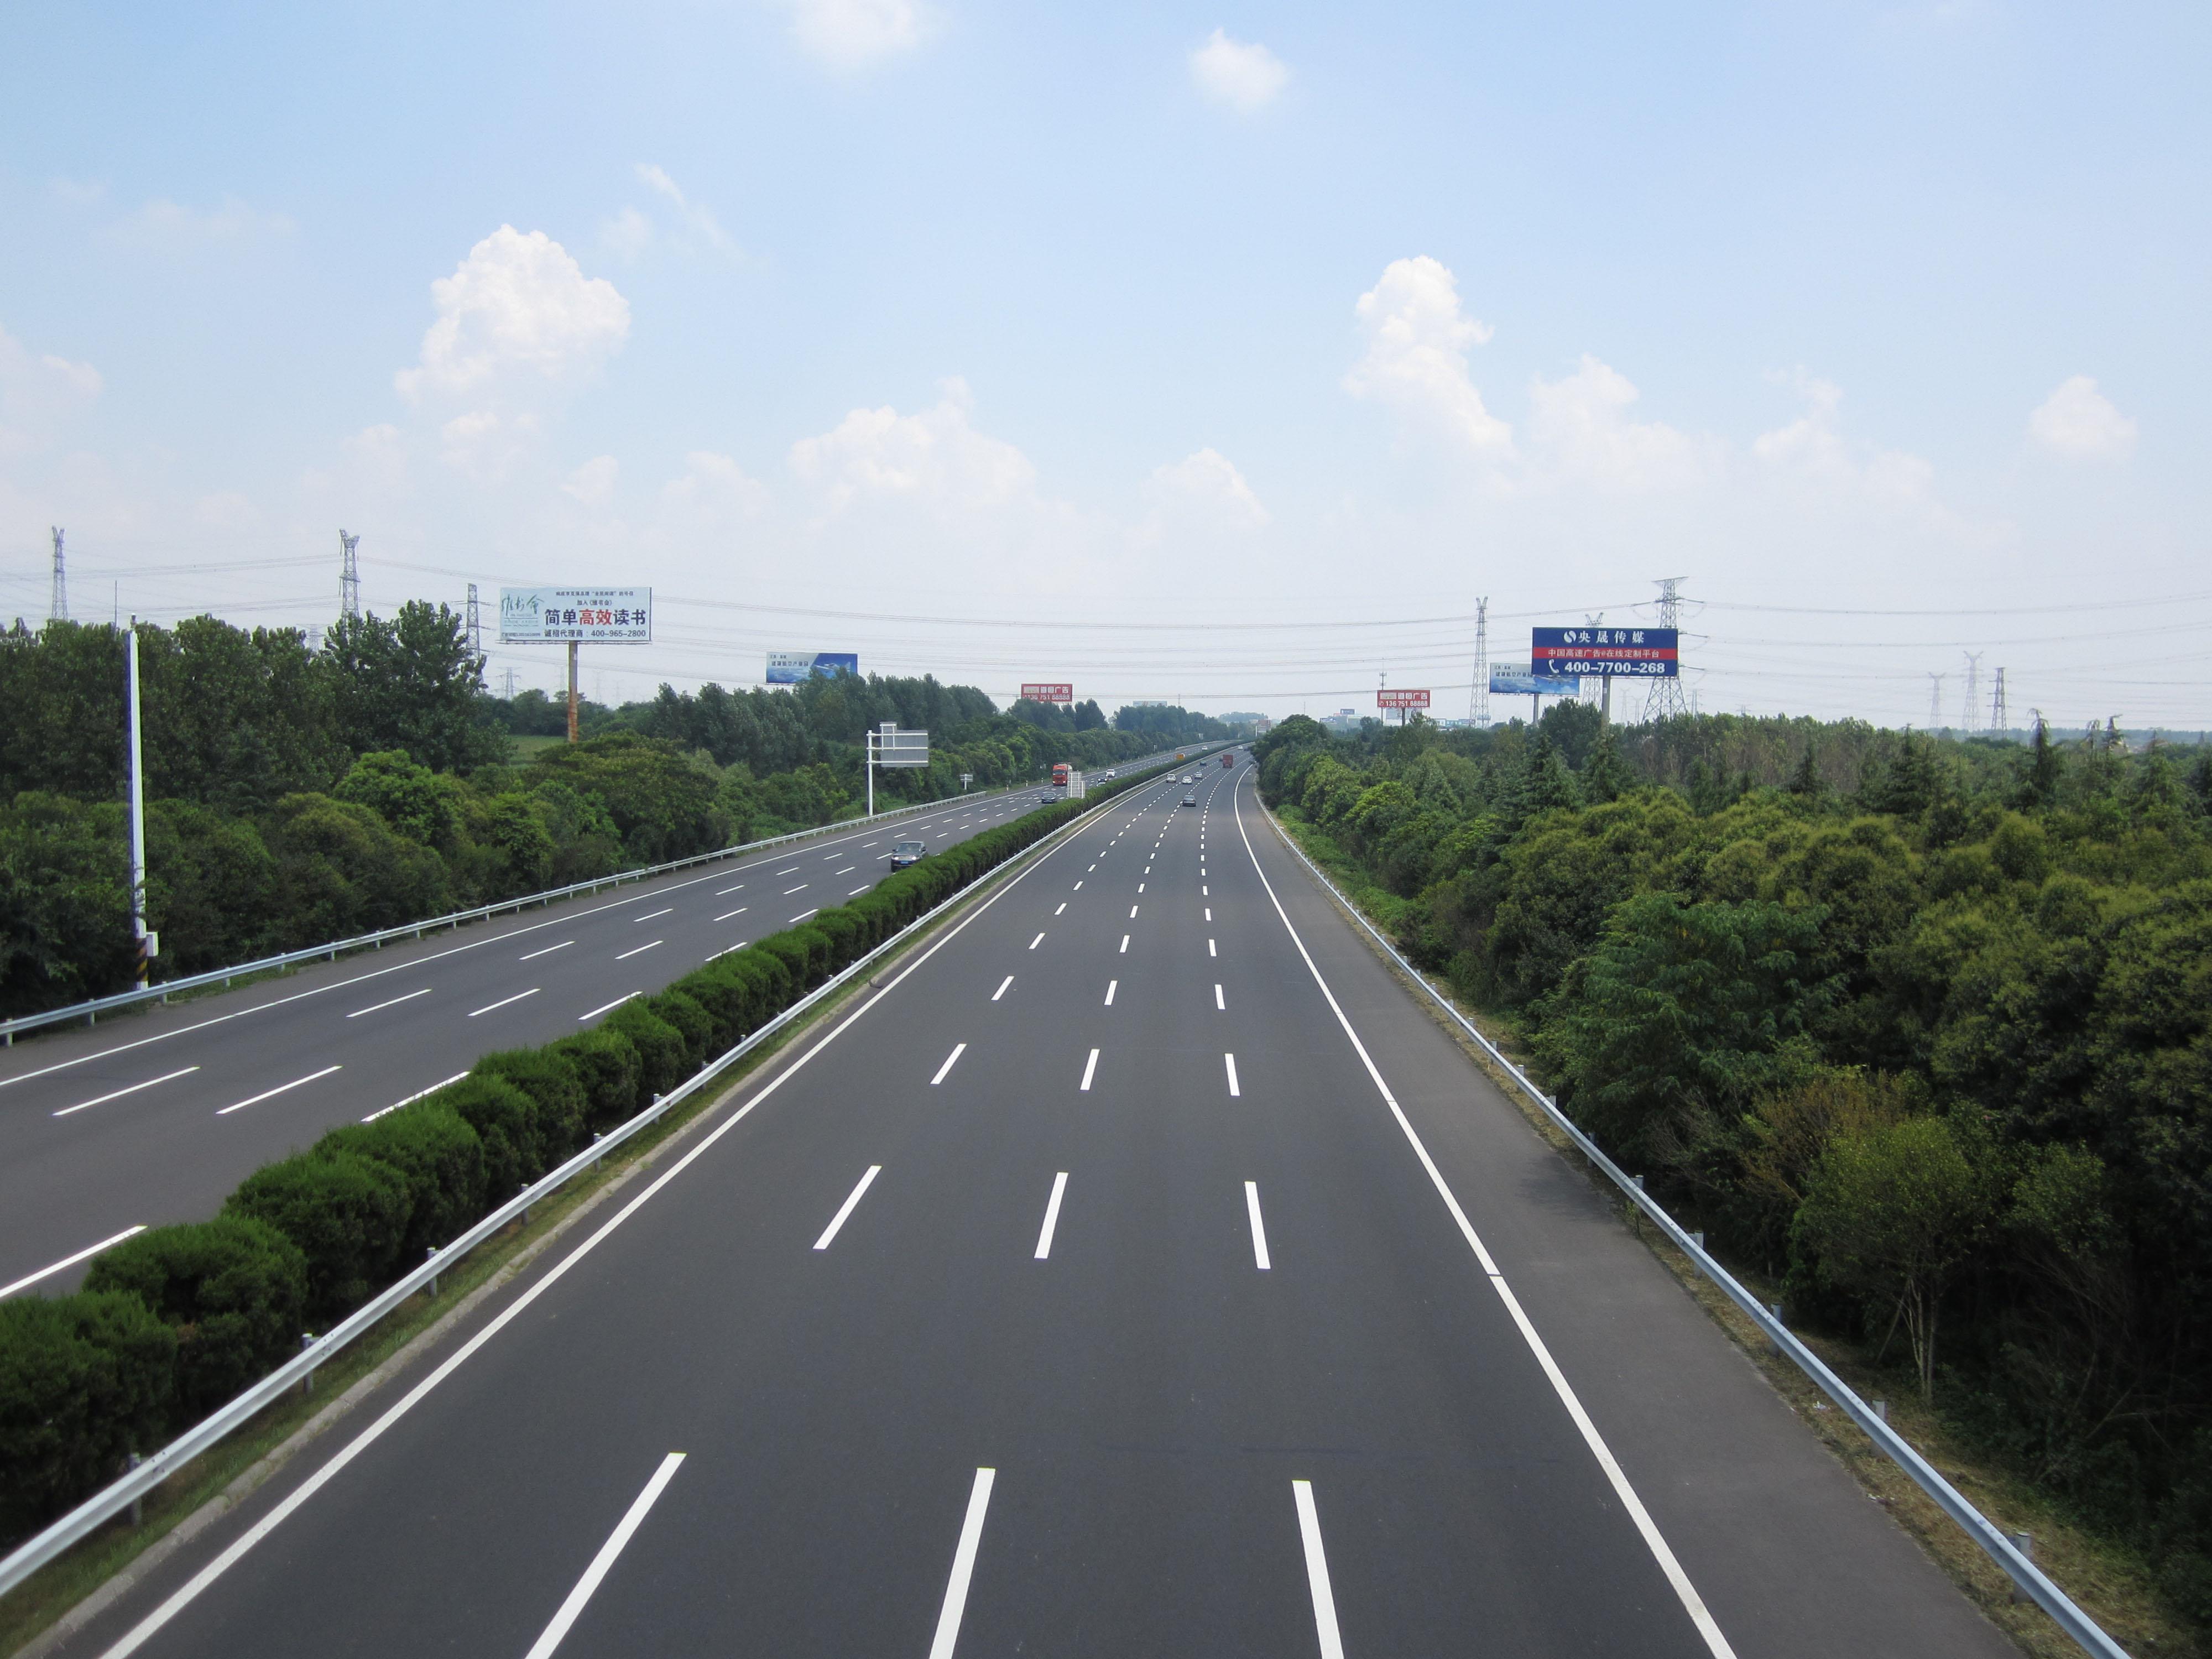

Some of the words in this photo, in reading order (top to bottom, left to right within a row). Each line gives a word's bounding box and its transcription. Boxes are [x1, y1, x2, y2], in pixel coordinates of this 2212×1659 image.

[544, 609, 646, 625] 简单高效读书
[1564, 661, 1666, 673] 400-7700-268
